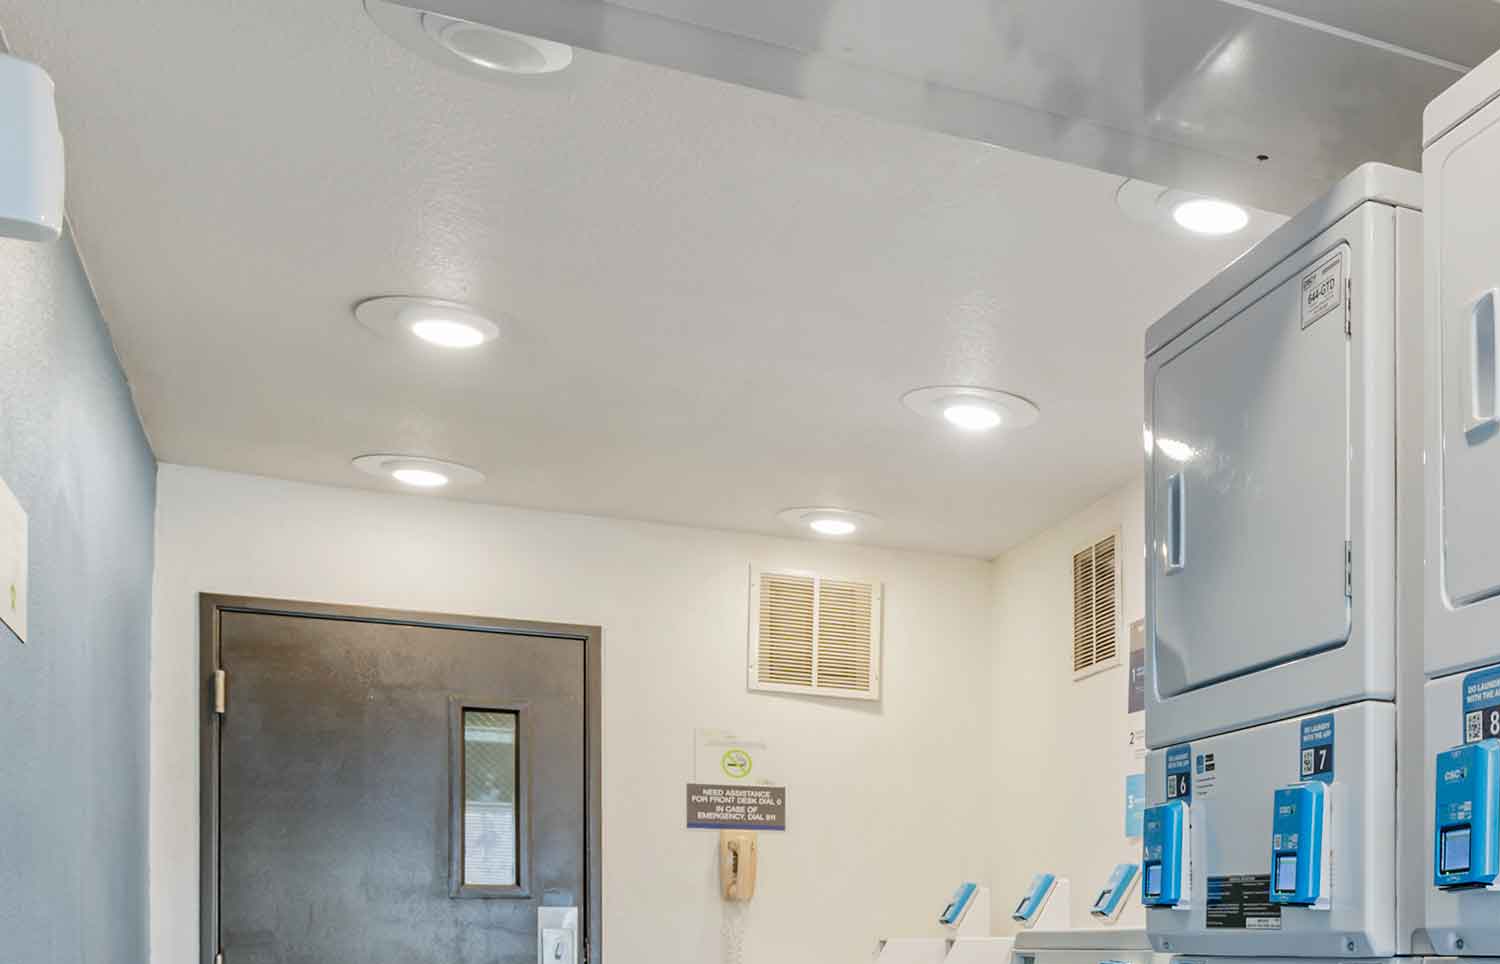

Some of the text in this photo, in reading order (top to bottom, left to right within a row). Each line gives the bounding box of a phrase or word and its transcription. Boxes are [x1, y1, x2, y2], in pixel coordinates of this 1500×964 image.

[1490, 711, 1499, 735] 8
[1320, 749, 1327, 770] 7
[1180, 776, 1186, 794] 6
